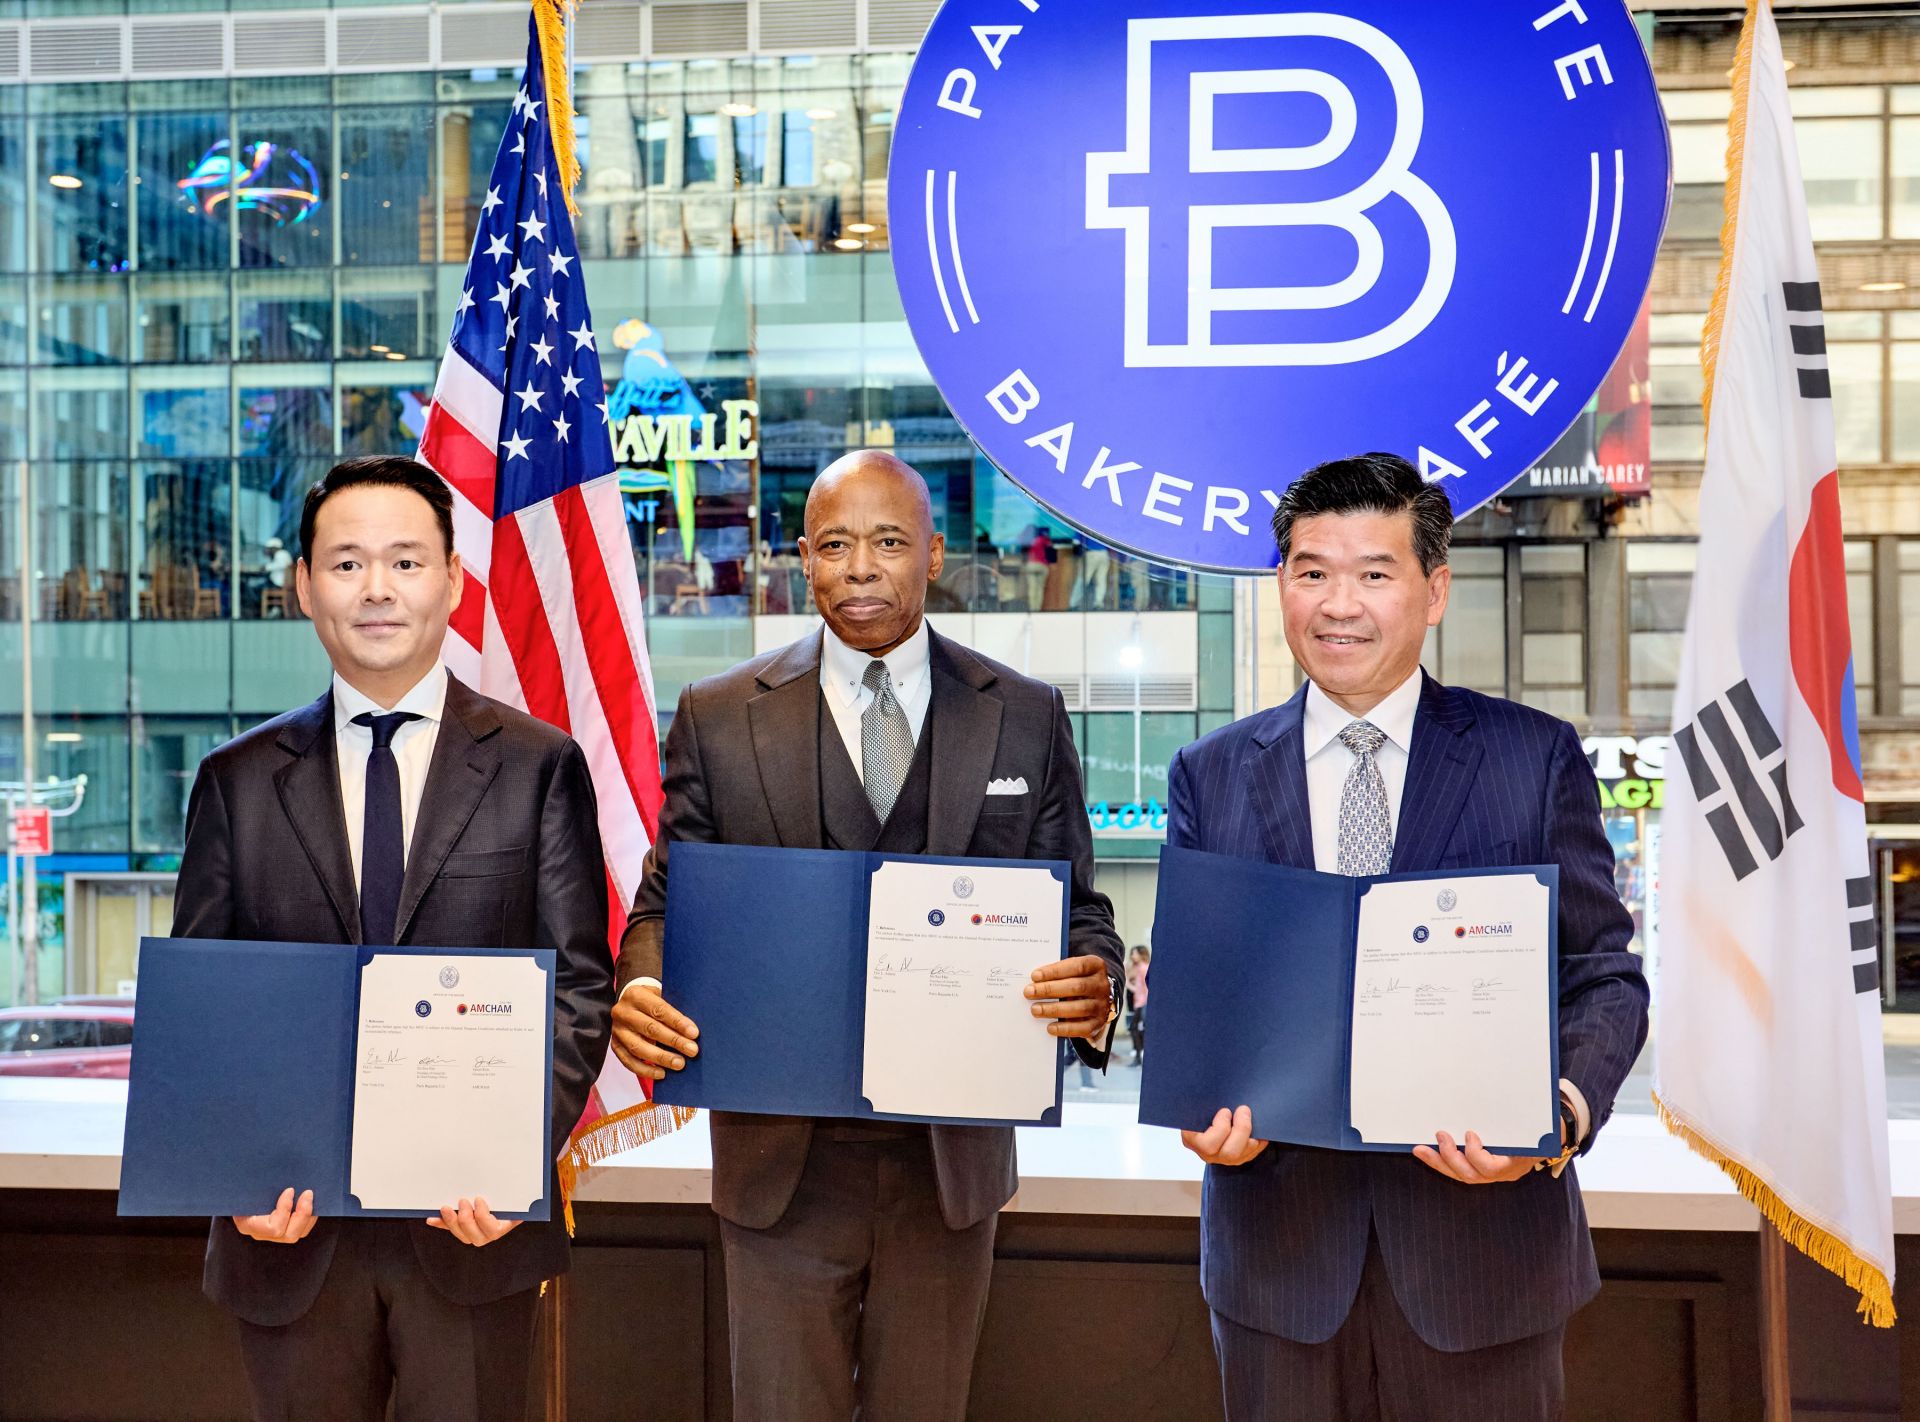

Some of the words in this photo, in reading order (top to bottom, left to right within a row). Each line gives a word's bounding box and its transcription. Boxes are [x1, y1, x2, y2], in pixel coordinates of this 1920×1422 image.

[936, 0, 1040, 119] PA
[985, 368, 1280, 535] BAKER
[1418, 350, 1559, 484] AFÉ
[1530, 465, 1590, 487] MARIAH
[1596, 463, 1645, 484] CAREY
[985, 914, 1028, 925] AMCHAM
[1468, 924, 1512, 935] AMCHAM
[470, 1003, 512, 1014] AMCHAM
